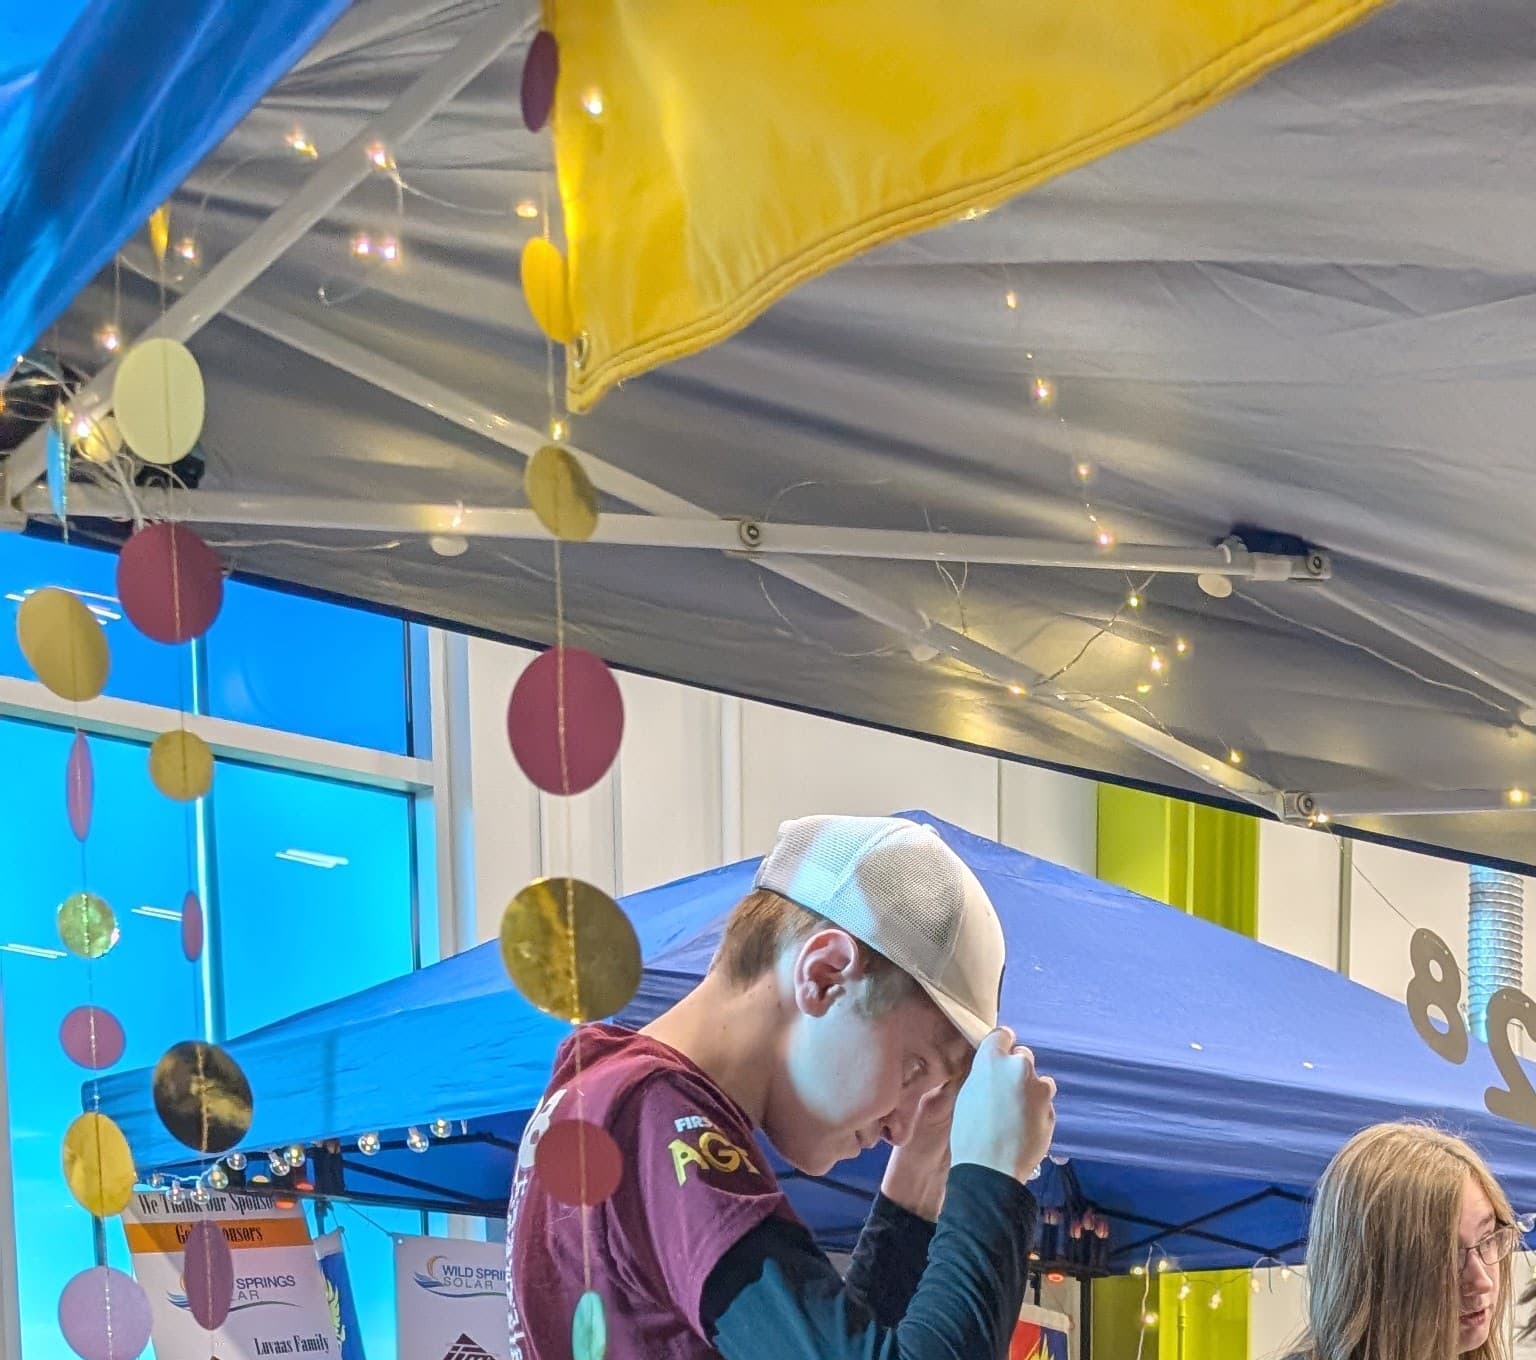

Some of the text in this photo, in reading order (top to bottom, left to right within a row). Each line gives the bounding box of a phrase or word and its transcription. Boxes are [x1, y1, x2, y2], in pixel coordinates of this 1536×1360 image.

[674, 1115, 718, 1133] FIRS
[138, 1193, 158, 1214] We
[229, 1191, 274, 1215] Sponso
[221, 1226, 264, 1242] onsors
[442, 1264, 507, 1281] WILD SPRI
[236, 1275, 296, 1290] SPRINGS
[443, 1276, 493, 1289] SOLAR
[254, 1332, 330, 1356] Luvaas Family
